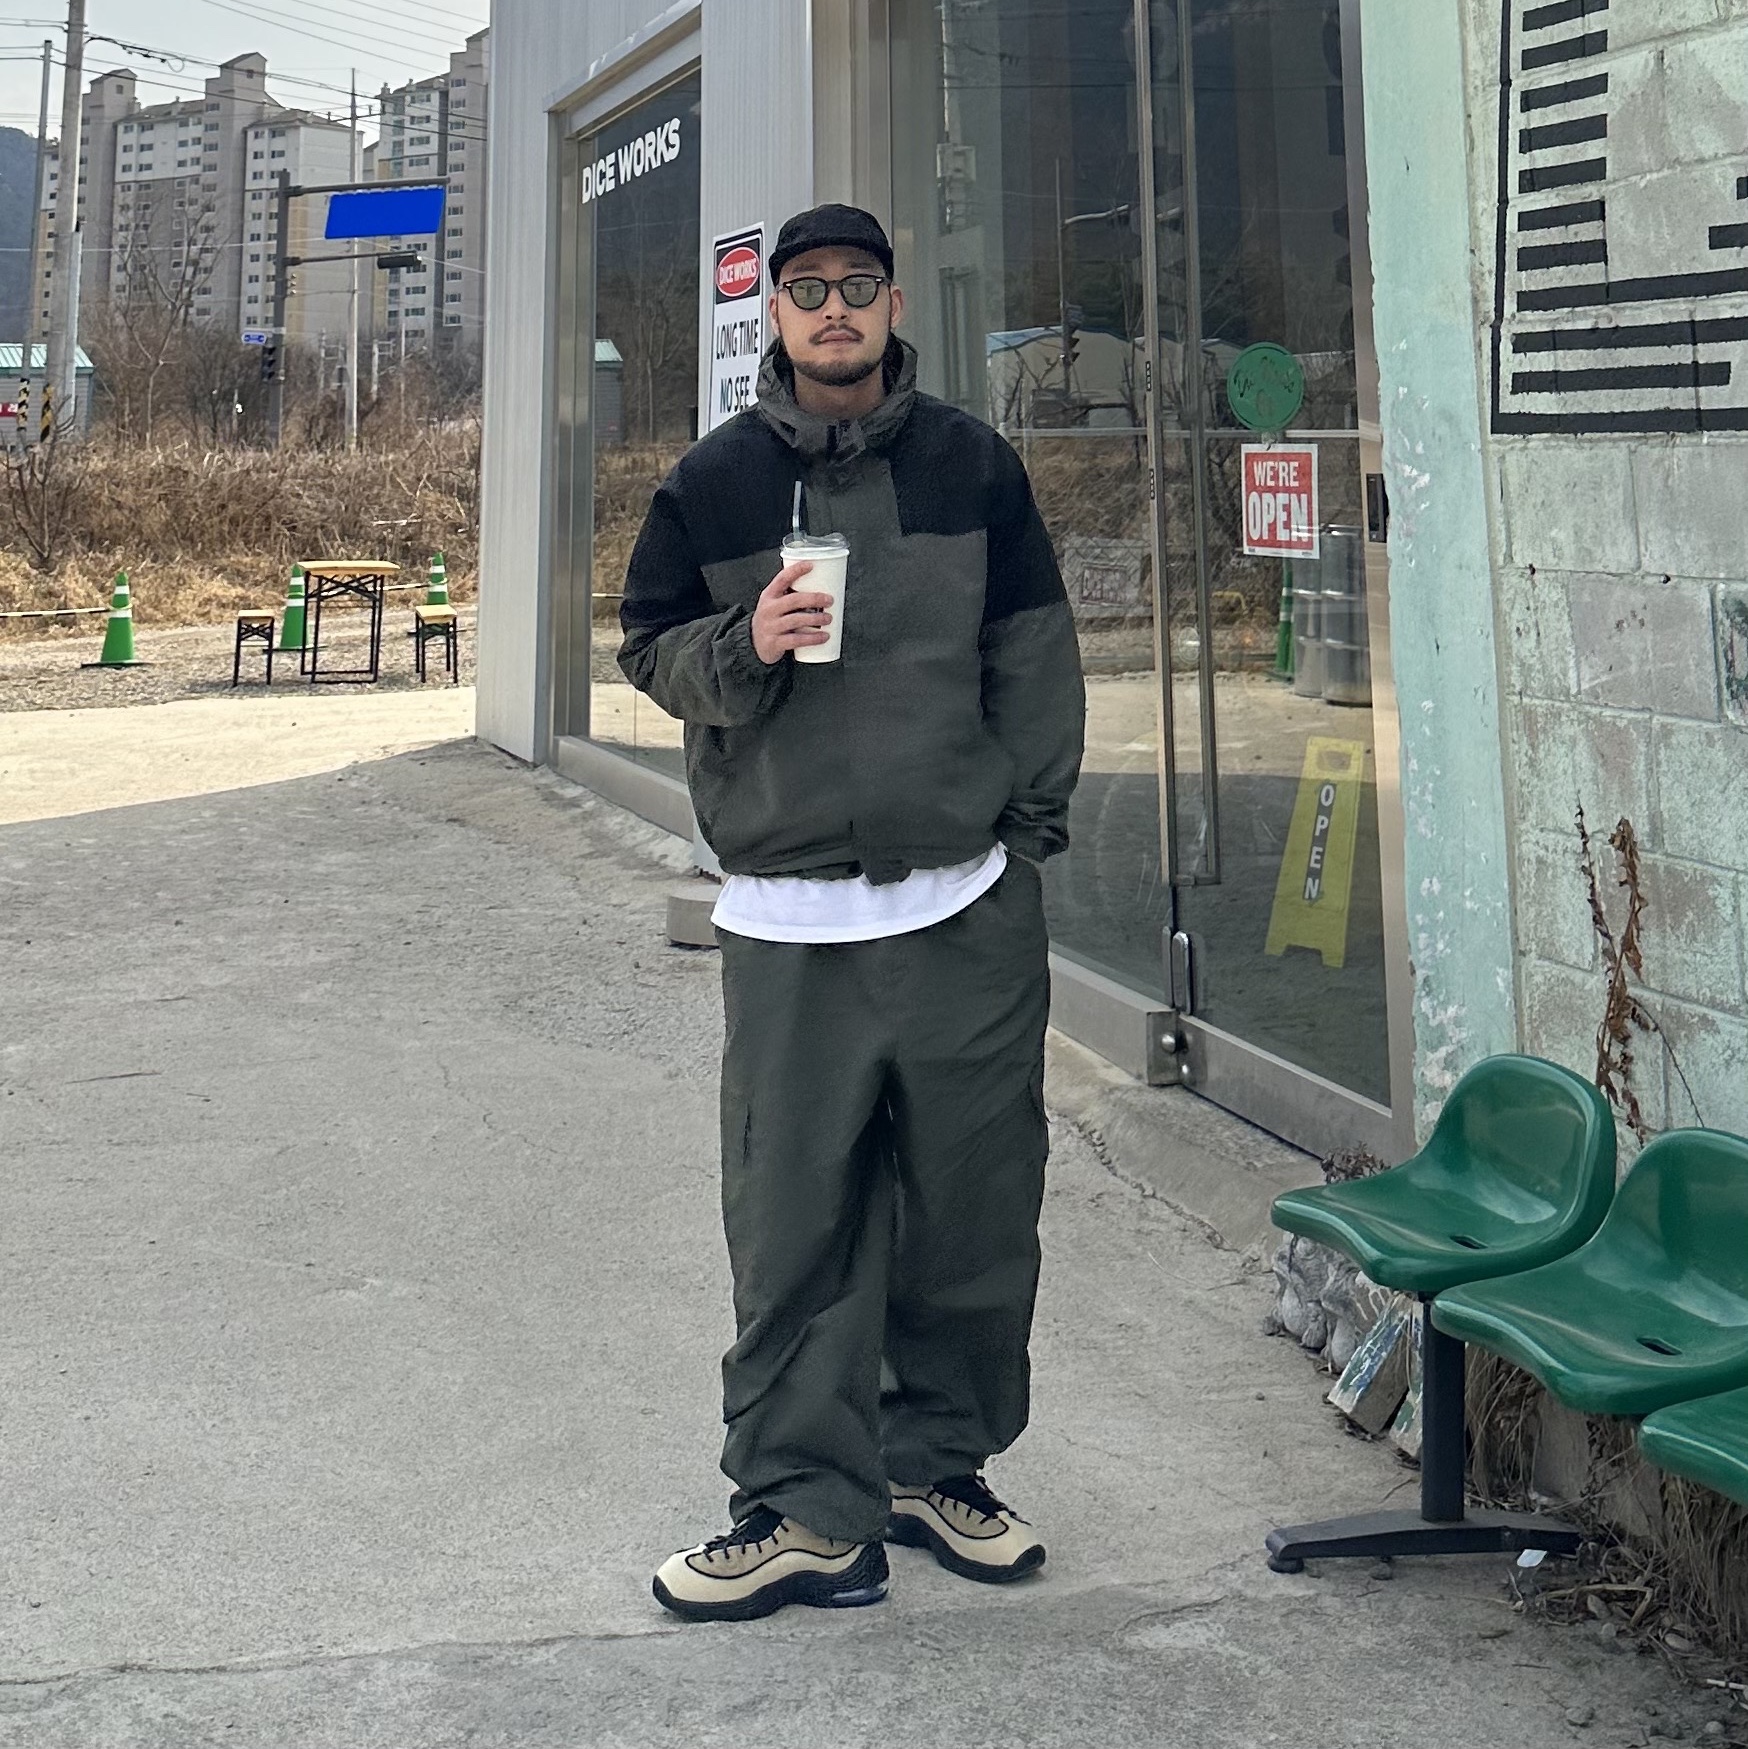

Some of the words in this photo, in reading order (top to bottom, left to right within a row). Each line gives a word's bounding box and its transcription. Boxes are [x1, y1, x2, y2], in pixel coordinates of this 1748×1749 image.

[582, 153, 616, 204] DICE
[618, 118, 681, 186] WORKS
[719, 264, 734, 286] DICE
[734, 257, 757, 281] WORKS
[716, 322, 738, 360] LONG
[739, 318, 759, 357] TIME
[720, 377, 733, 413] NO
[734, 375, 750, 412] SEE
[1253, 460, 1300, 488] WE'RE
[1248, 490, 1309, 543] OPEN
[1304, 784, 1335, 900] OPEN
